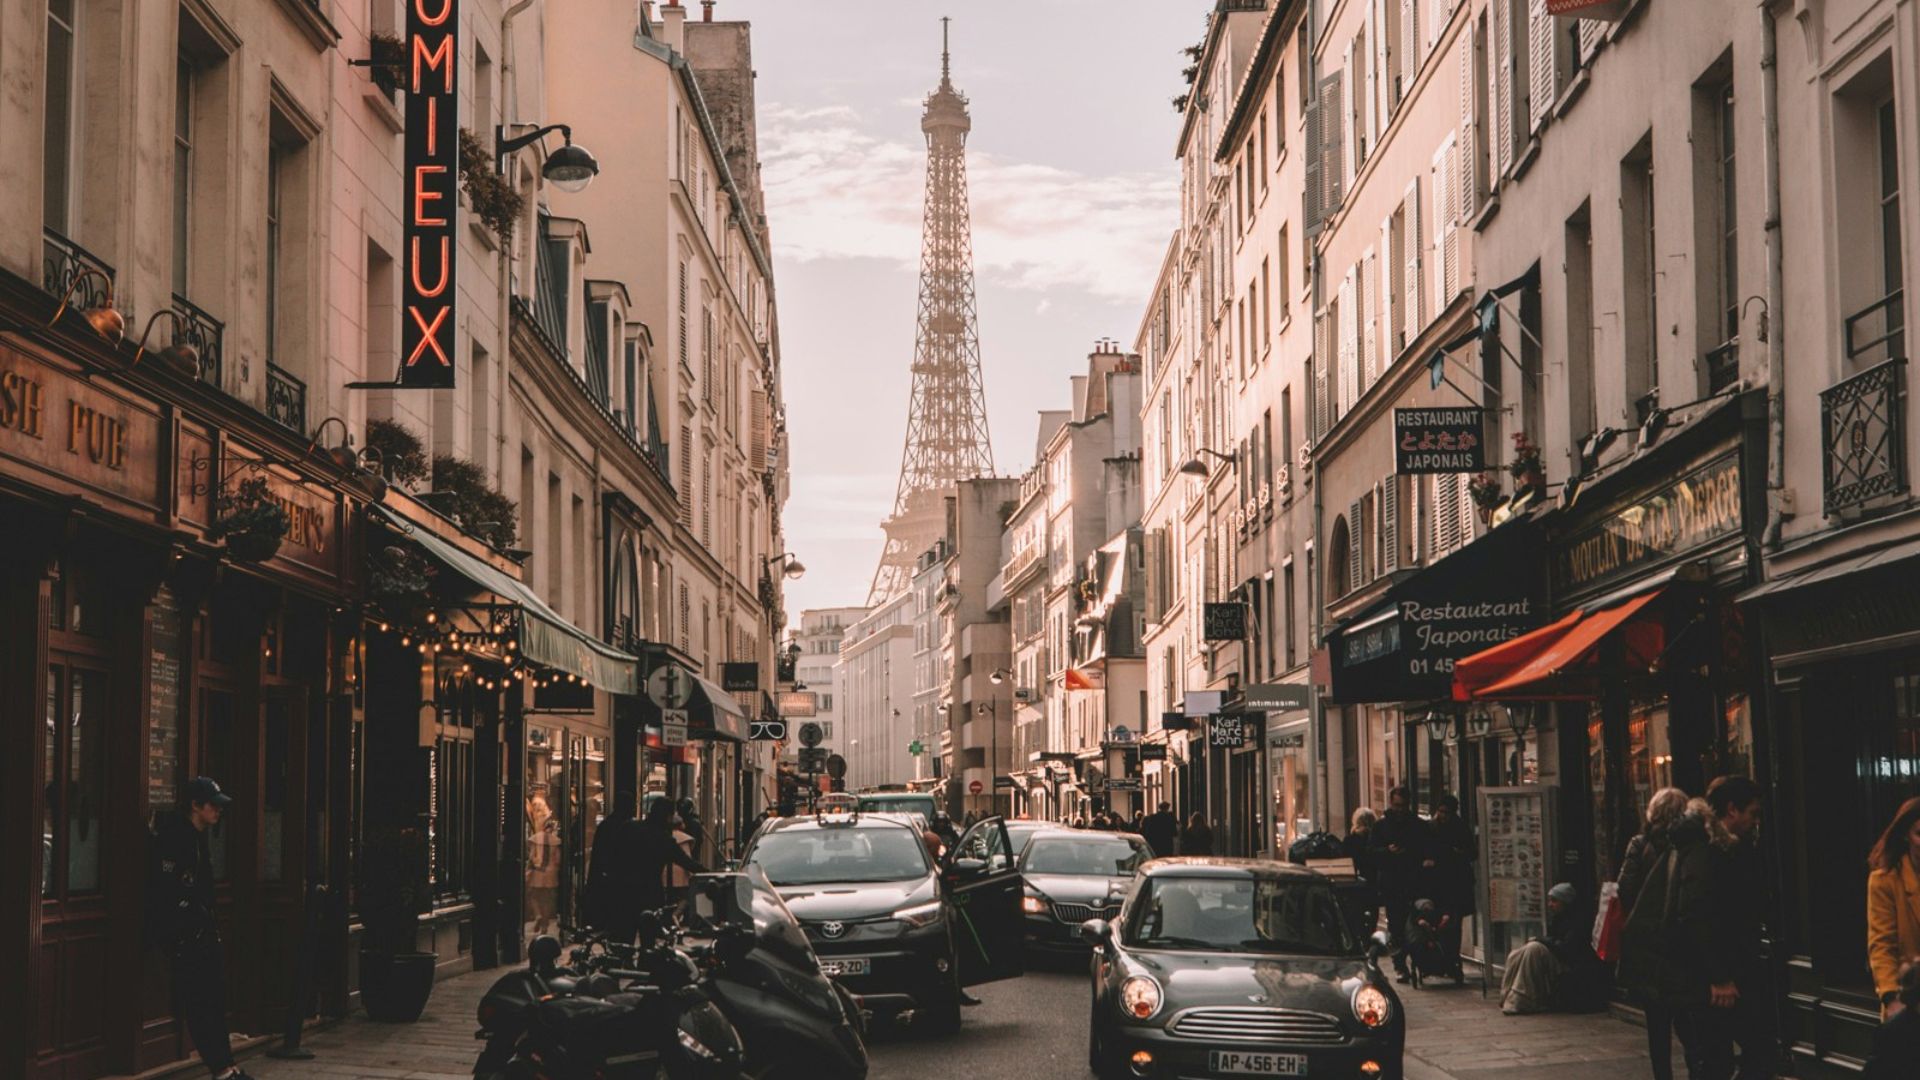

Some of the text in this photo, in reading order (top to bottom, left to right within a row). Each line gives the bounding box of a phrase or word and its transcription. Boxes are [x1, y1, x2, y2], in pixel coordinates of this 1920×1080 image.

[1397, 411, 1478, 426] RESTAURANT
[1400, 431, 1477, 451] とよたか
[1406, 454, 1473, 469] JAPONAIS
[1570, 529, 1620, 583] MOULIN
[1626, 522, 1644, 562] DE
[1650, 503, 1675, 550] LA
[1677, 466, 1741, 539] VIERGE
[1212, 606, 1240, 618] Karl
[1401, 597, 1530, 621] Restaurant
[1206, 616, 1241, 628] Marc
[1207, 625, 1242, 638] John
[1416, 623, 1519, 651] Japonais
[1410, 658, 1455, 674] 01 45
[1216, 716, 1242, 728] Karl
[1211, 725, 1242, 736] Marc
[1211, 734, 1242, 745] John
[1221, 1053, 1296, 1073] AP-456-EH
